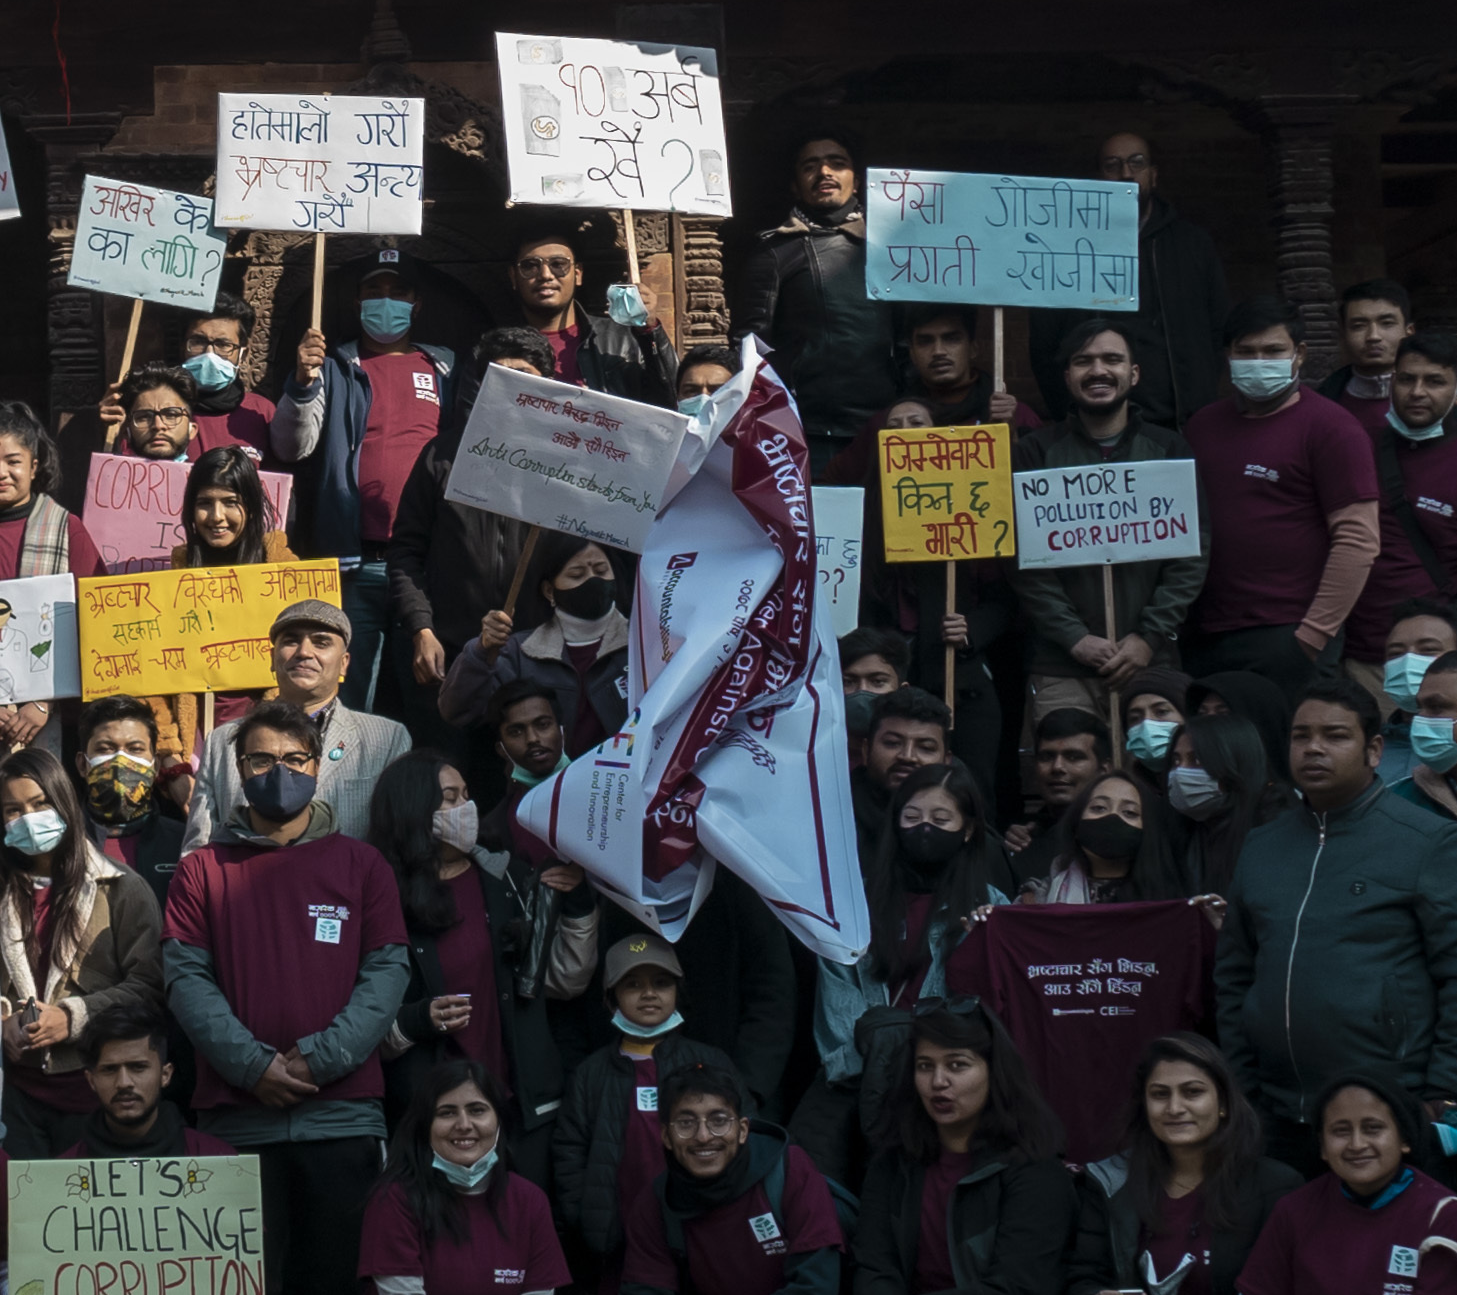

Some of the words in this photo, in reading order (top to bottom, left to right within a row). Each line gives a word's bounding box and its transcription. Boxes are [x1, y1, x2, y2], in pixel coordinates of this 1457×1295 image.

[88, 226, 134, 265] का
[200, 248, 221, 287] ?
[94, 459, 280, 523] CORRUN
[1022, 477, 1049, 500] NO
[1063, 469, 1135, 498] MORE
[1033, 496, 1137, 527] POLLUTION
[1150, 498, 1175, 515] BY
[992, 521, 1009, 556] ?
[1048, 514, 1188, 552] CORRUPTION
[704, 628, 762, 737] Against
[591, 770, 600, 789] and
[617, 774, 629, 806] Center
[586, 792, 600, 841] Innovation
[597, 772, 615, 851] Entrepreneurship
[614, 808, 626, 821] for
[1100, 1006, 1119, 1016] CEI
[89, 1159, 185, 1199] LET'S
[42, 1205, 261, 1258] CHALLENGE
